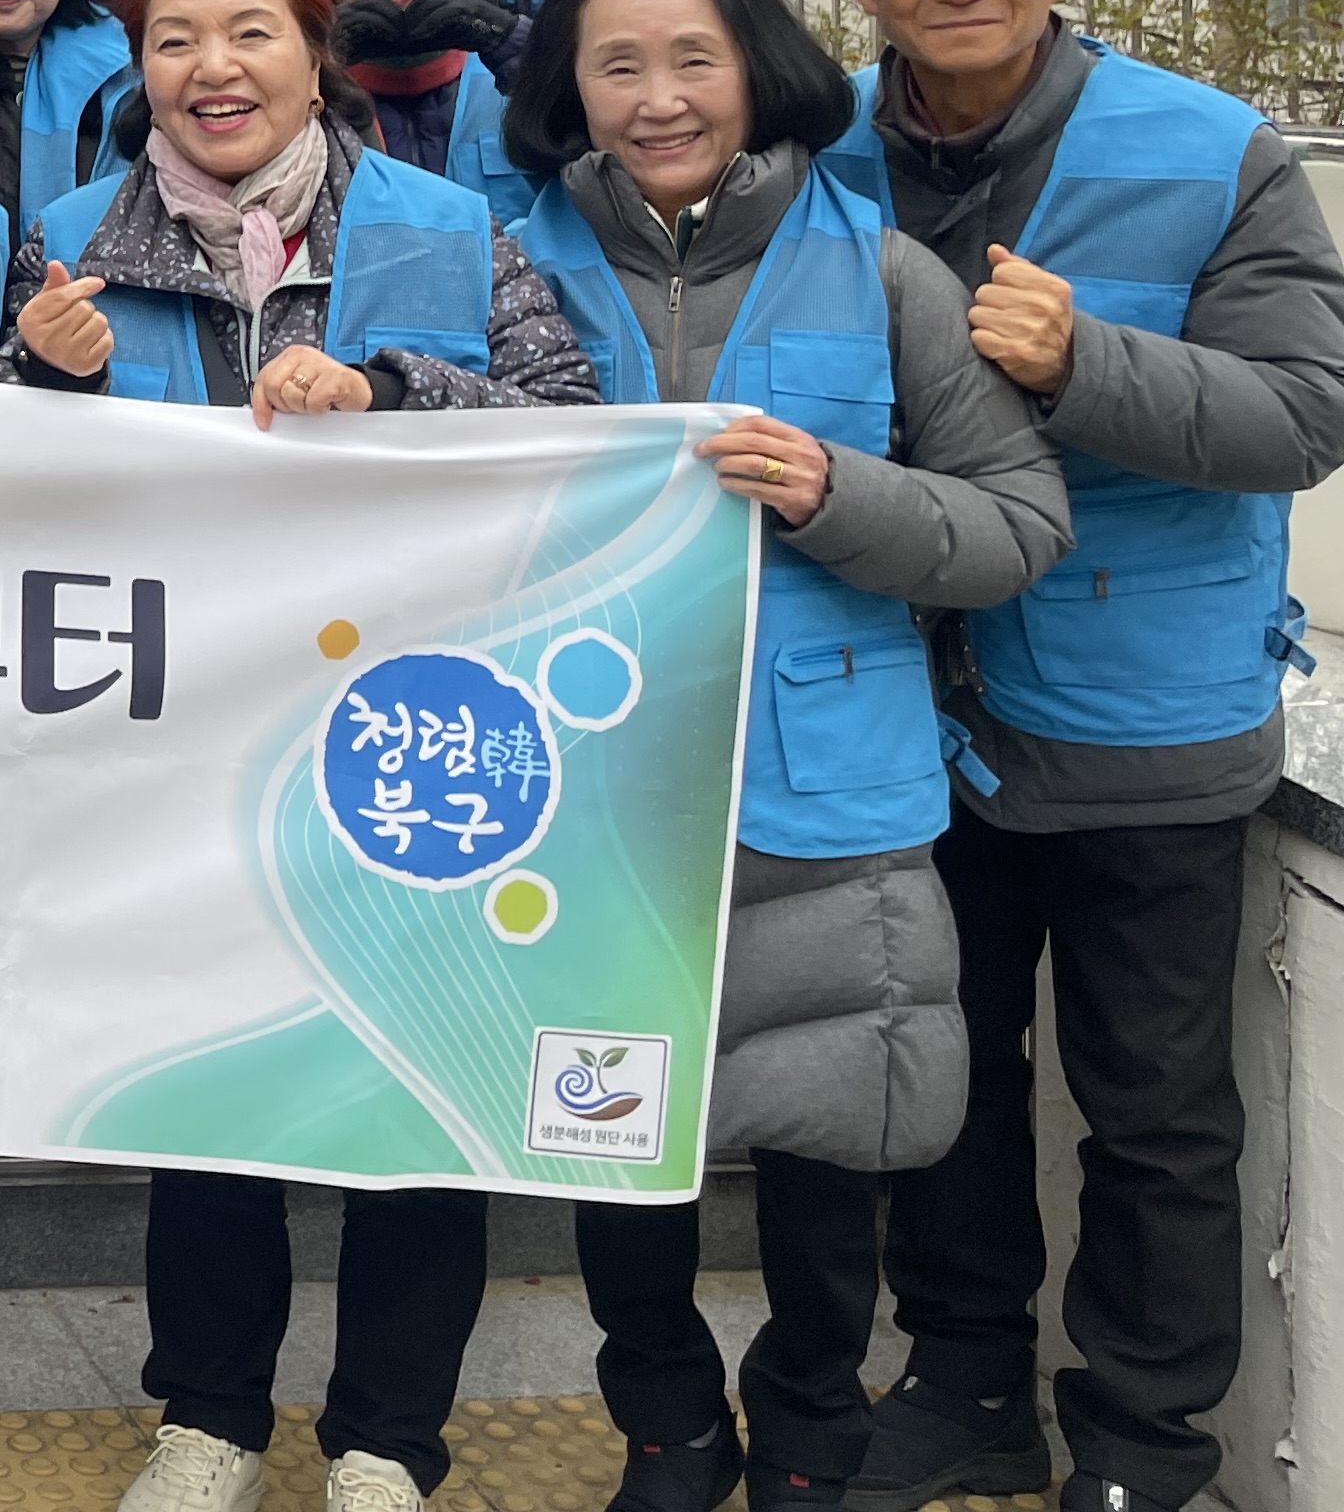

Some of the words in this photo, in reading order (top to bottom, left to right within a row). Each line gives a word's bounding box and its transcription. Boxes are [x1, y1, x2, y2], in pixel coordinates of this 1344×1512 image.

[357, 778, 504, 855] 북구
[595, 1130, 620, 1146] 원단
[623, 1132, 649, 1148] 사용
